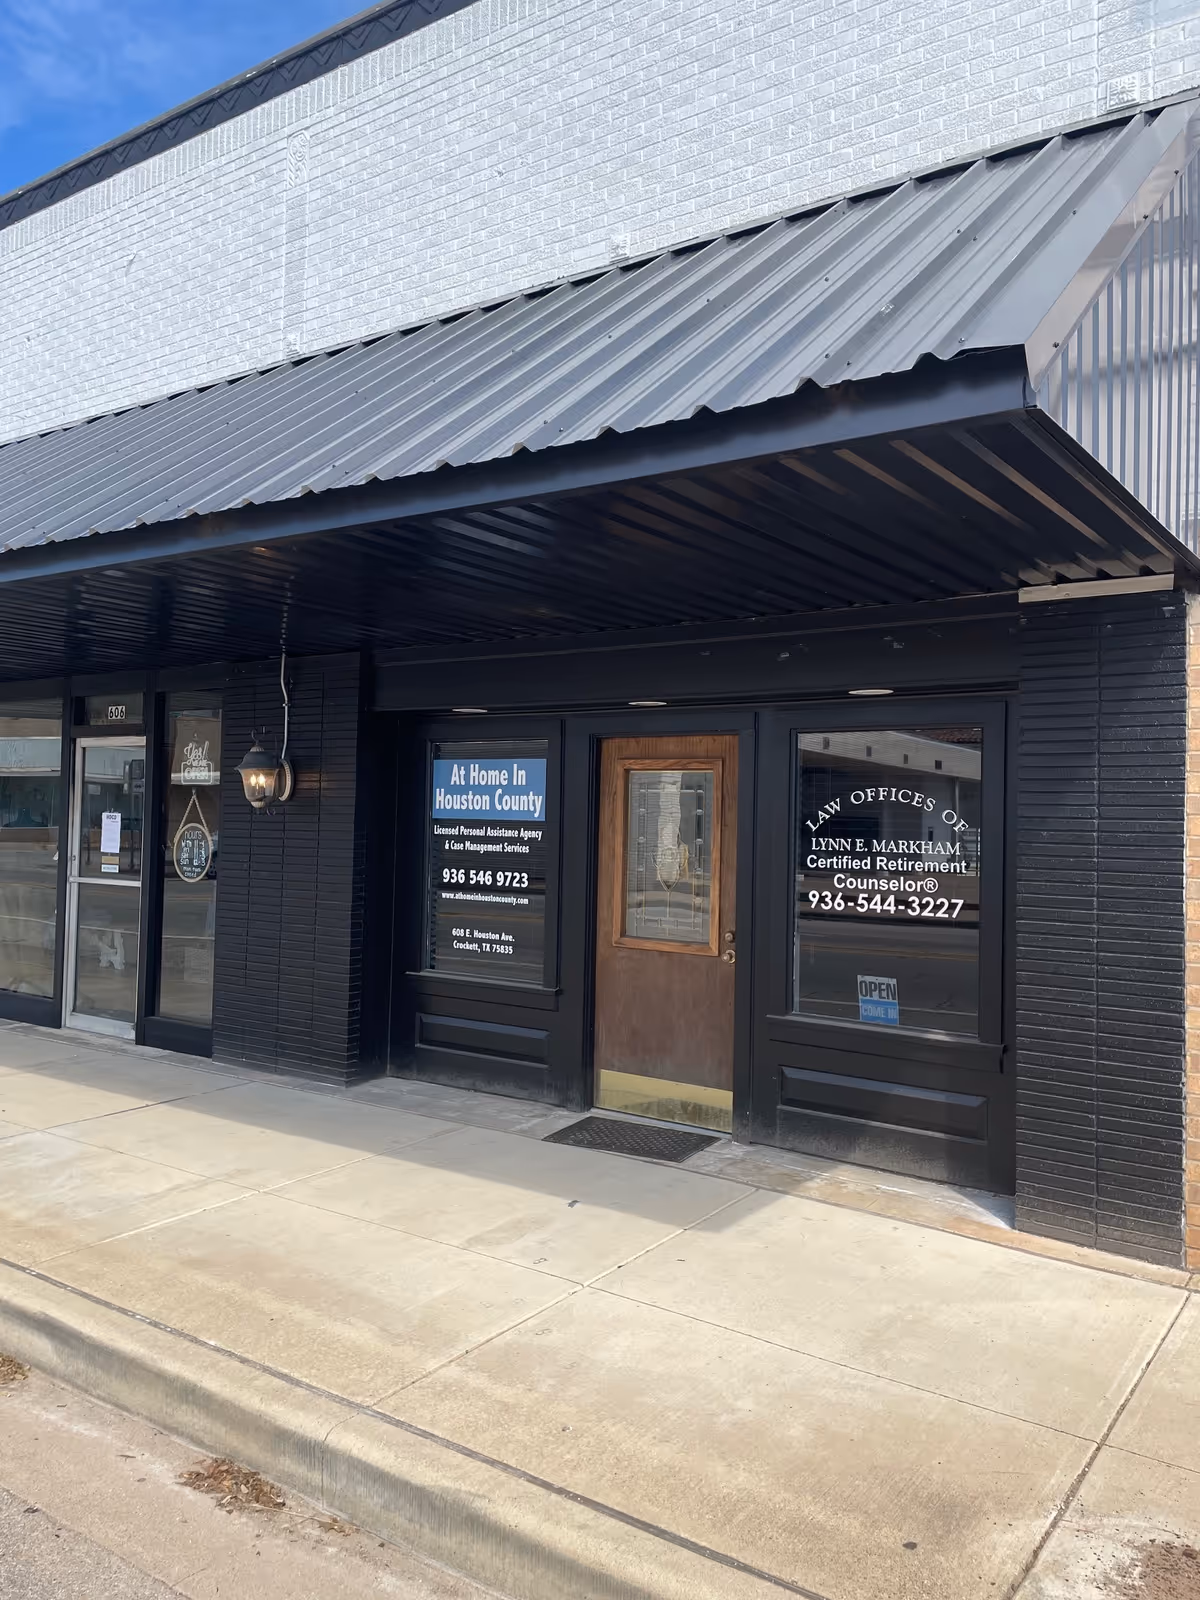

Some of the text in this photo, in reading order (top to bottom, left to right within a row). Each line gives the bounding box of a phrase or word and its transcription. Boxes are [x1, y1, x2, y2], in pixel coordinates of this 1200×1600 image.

[109, 707, 125, 719] 606
[450, 763, 526, 785] At Home In
[436, 788, 542, 817] Houston County
[805, 787, 969, 832] LAW OFFICES OF
[434, 825, 542, 840] Licensed Personal Assistance Agency
[445, 840, 529, 854] & Case Management Services
[811, 838, 961, 855] LYNN E. MARKHAM
[806, 854, 967, 873] Certified Retirement
[442, 868, 529, 888] 936 546 9723
[441, 892, 529, 906] www.athomeinhoustoncounty.com
[808, 890, 964, 918] 936-544-3227
[452, 928, 515, 942] 608 E. Houston Ave.
[453, 940, 513, 954] Crockett, TX 75835
[859, 980, 897, 1000] OPEN
[862, 1005, 897, 1019] COME IN
